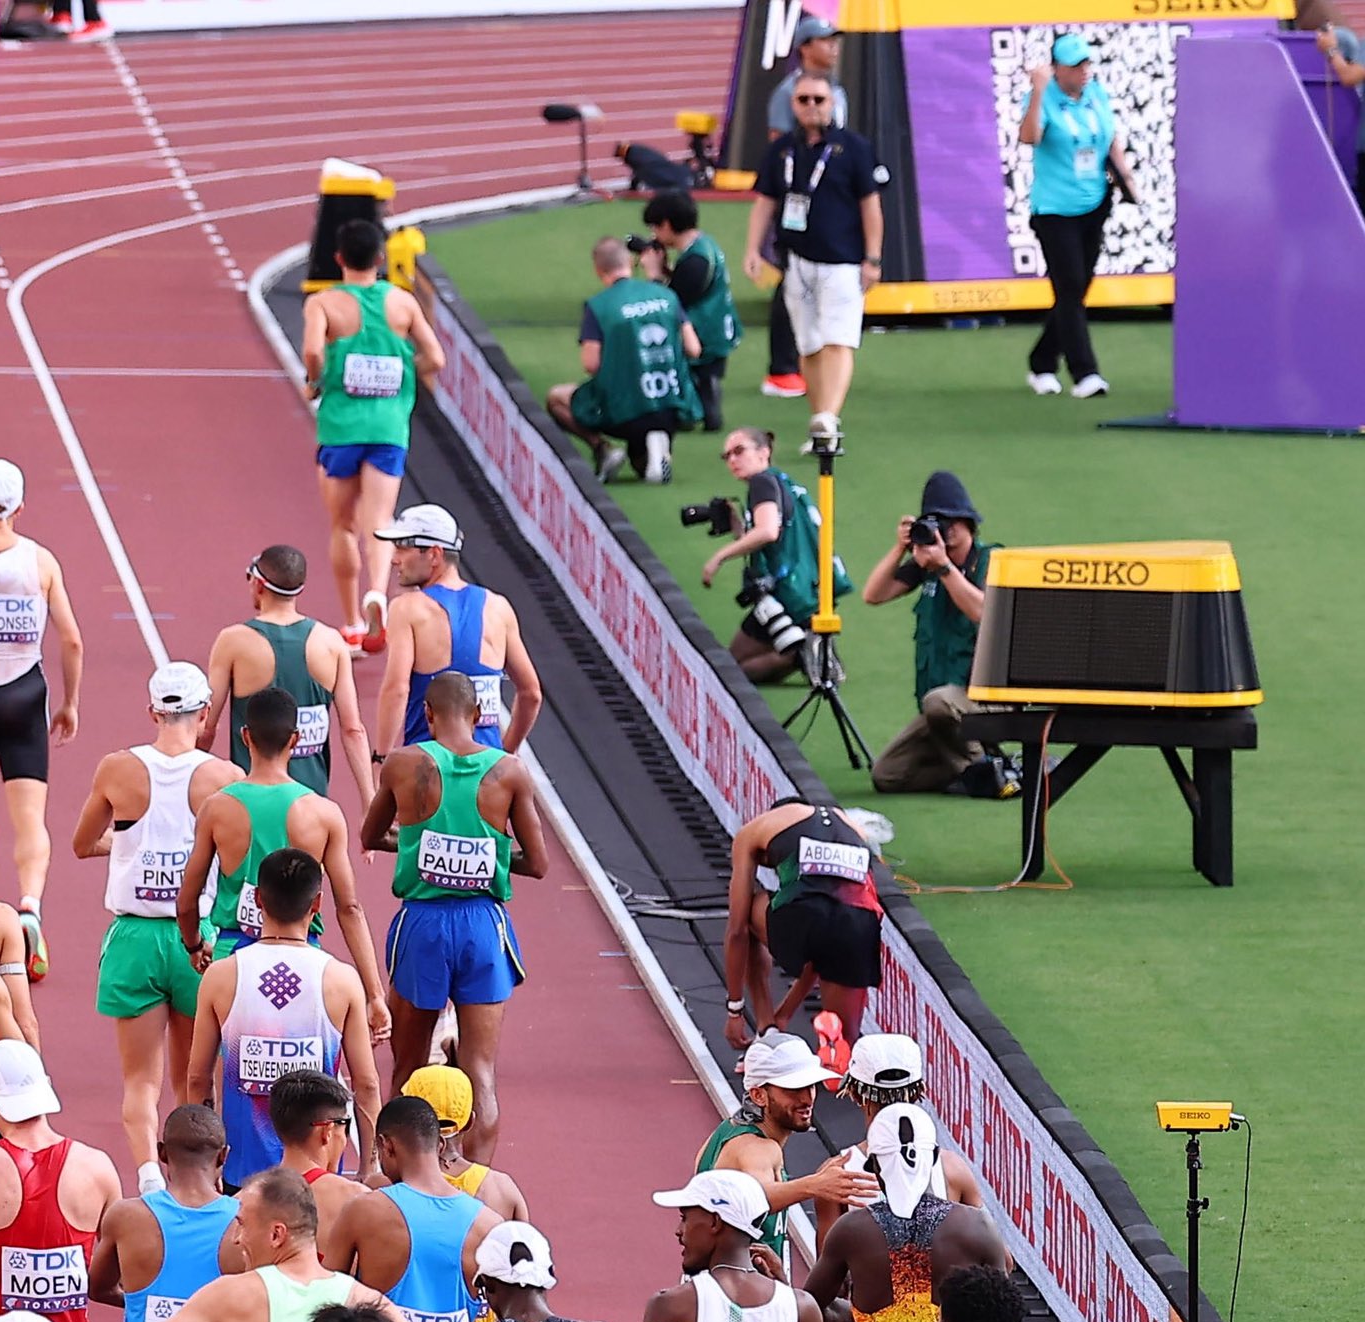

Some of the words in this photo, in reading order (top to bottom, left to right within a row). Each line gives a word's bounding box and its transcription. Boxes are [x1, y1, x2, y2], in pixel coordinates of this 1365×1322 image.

[932, 288, 1010, 308] SEIKO
[1042, 560, 1150, 586] SEIKO
[442, 838, 490, 857] TDK
[424, 852, 489, 877] PAULA
[263, 1040, 316, 1058] TDK
[1180, 1110, 1211, 1121] SEIKO
[982, 1080, 1036, 1248] HONDA
[28, 1250, 78, 1271] TDK
[10, 1274, 82, 1294] MOEN
